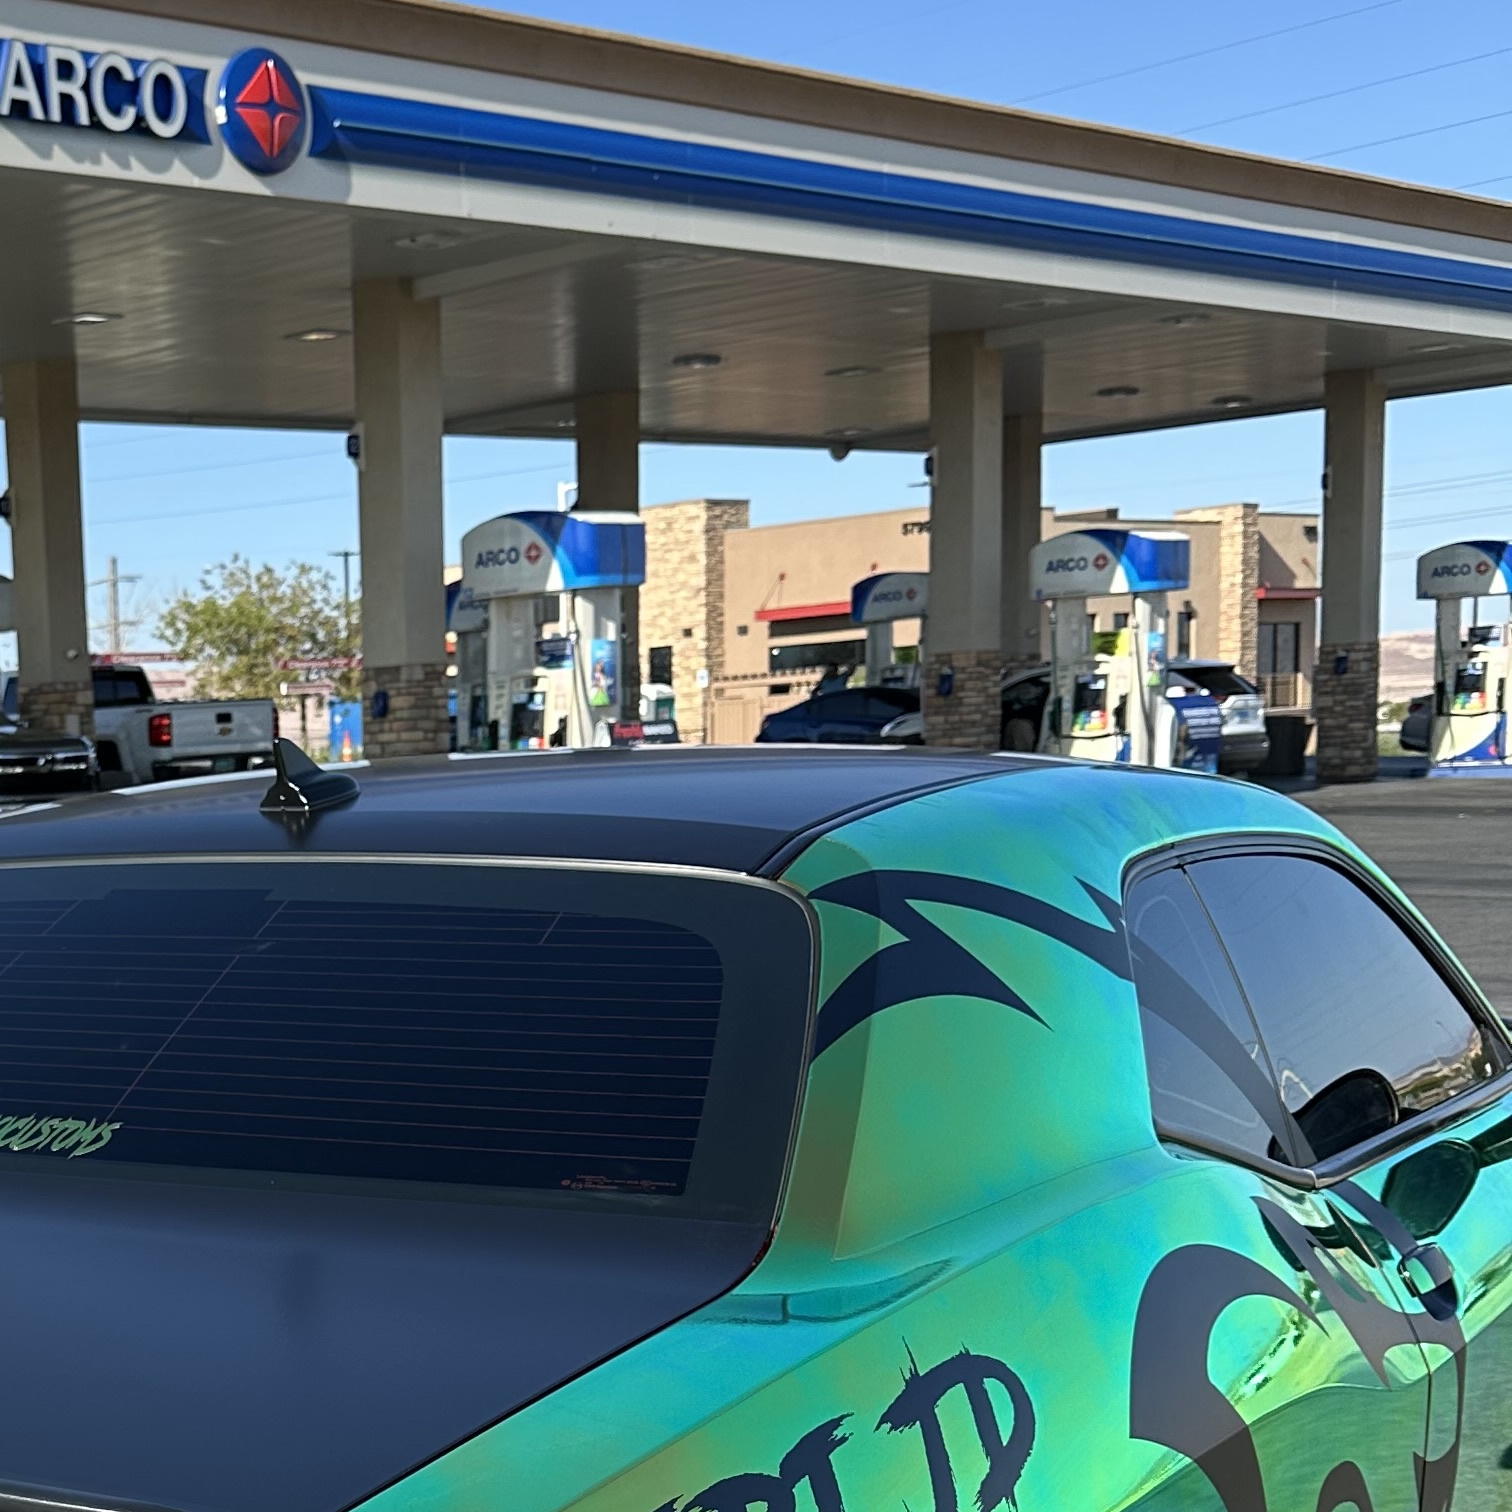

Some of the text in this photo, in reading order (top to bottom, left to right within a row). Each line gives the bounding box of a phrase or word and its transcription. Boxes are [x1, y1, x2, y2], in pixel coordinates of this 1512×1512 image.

[475, 548, 520, 569] ARCO
[1045, 556, 1088, 573] ARCO
[1431, 564, 1472, 578] ARCO
[872, 591, 903, 604] ARCO
